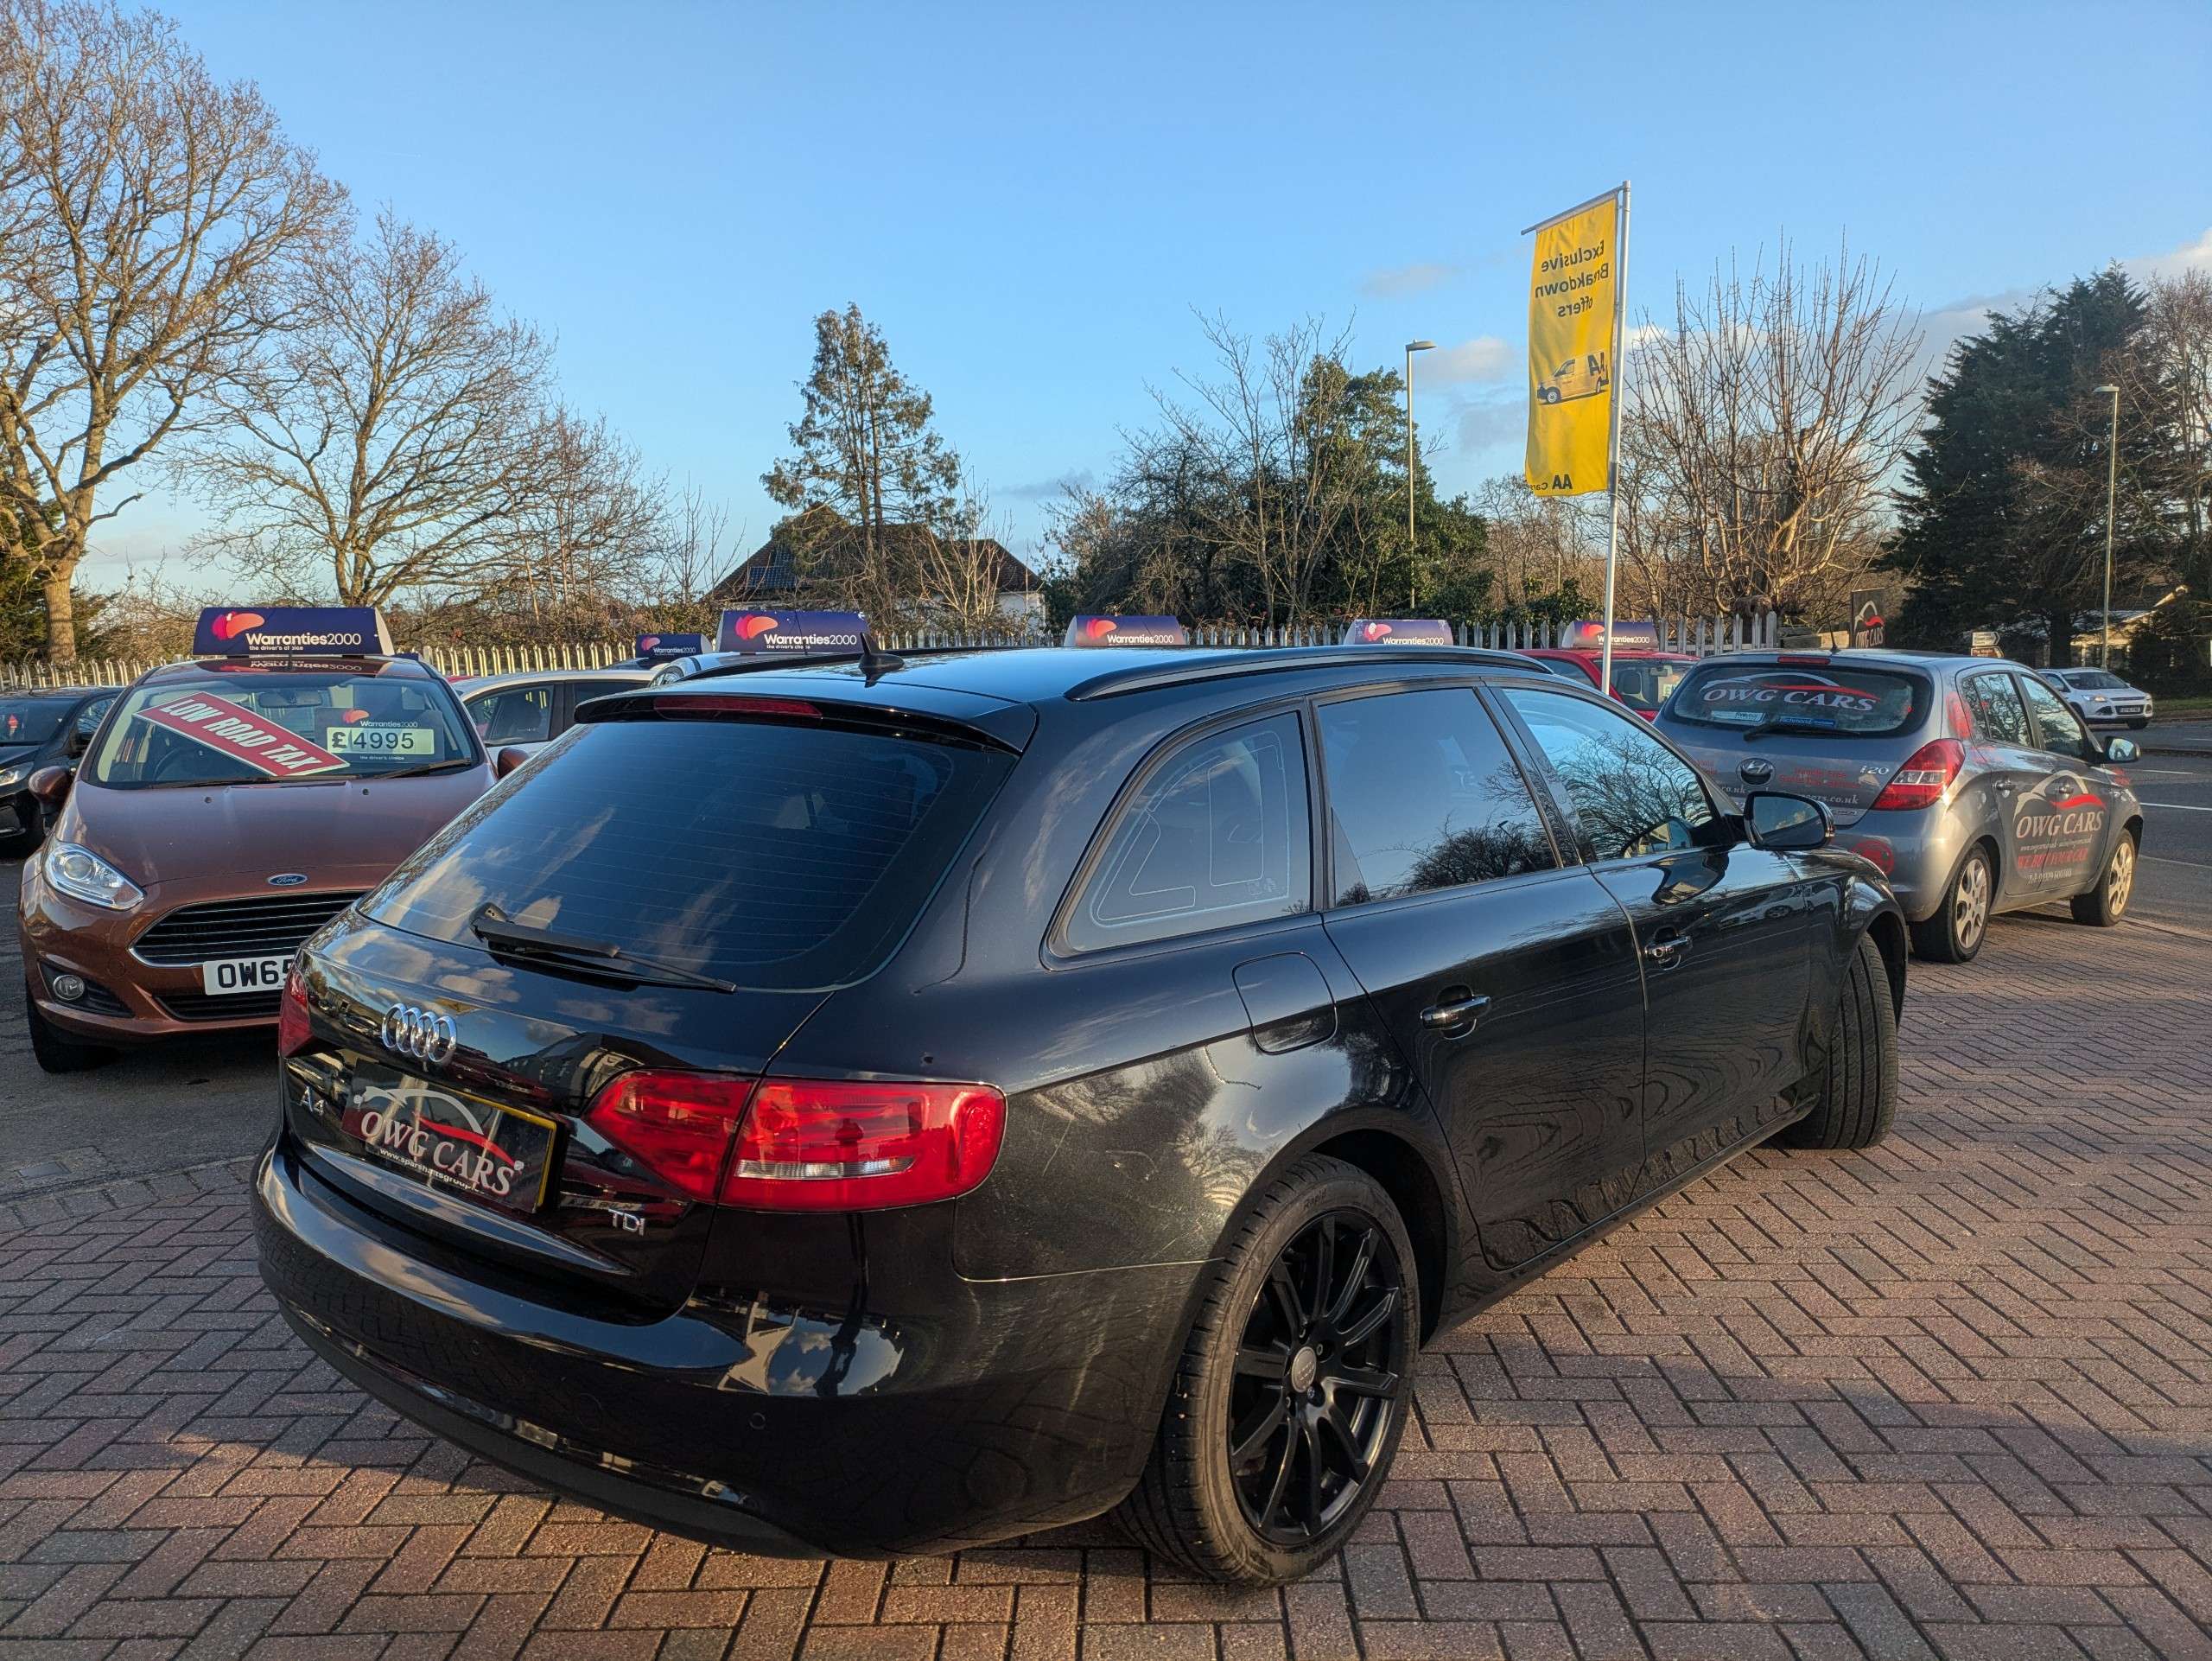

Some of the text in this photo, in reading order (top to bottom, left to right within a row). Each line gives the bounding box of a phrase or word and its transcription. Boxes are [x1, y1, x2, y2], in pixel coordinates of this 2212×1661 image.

[245, 632, 361, 646] Warranties2000
[763, 633, 857, 645] Warranties2000
[1107, 633, 1174, 644] Warranties2000
[1382, 637, 1445, 646] Warranties2000
[1597, 634, 1650, 644] Wranties2000
[1703, 689, 1877, 711] OWG CARS
[160, 698, 323, 770] LOW ROAD TAX
[2016, 811, 2104, 838] OWG CARS
[276, 875, 298, 884] Ford
[298, 1085, 325, 1116] A4
[360, 1111, 516, 1197] OWG CARS
[607, 1208, 645, 1237] TDI
